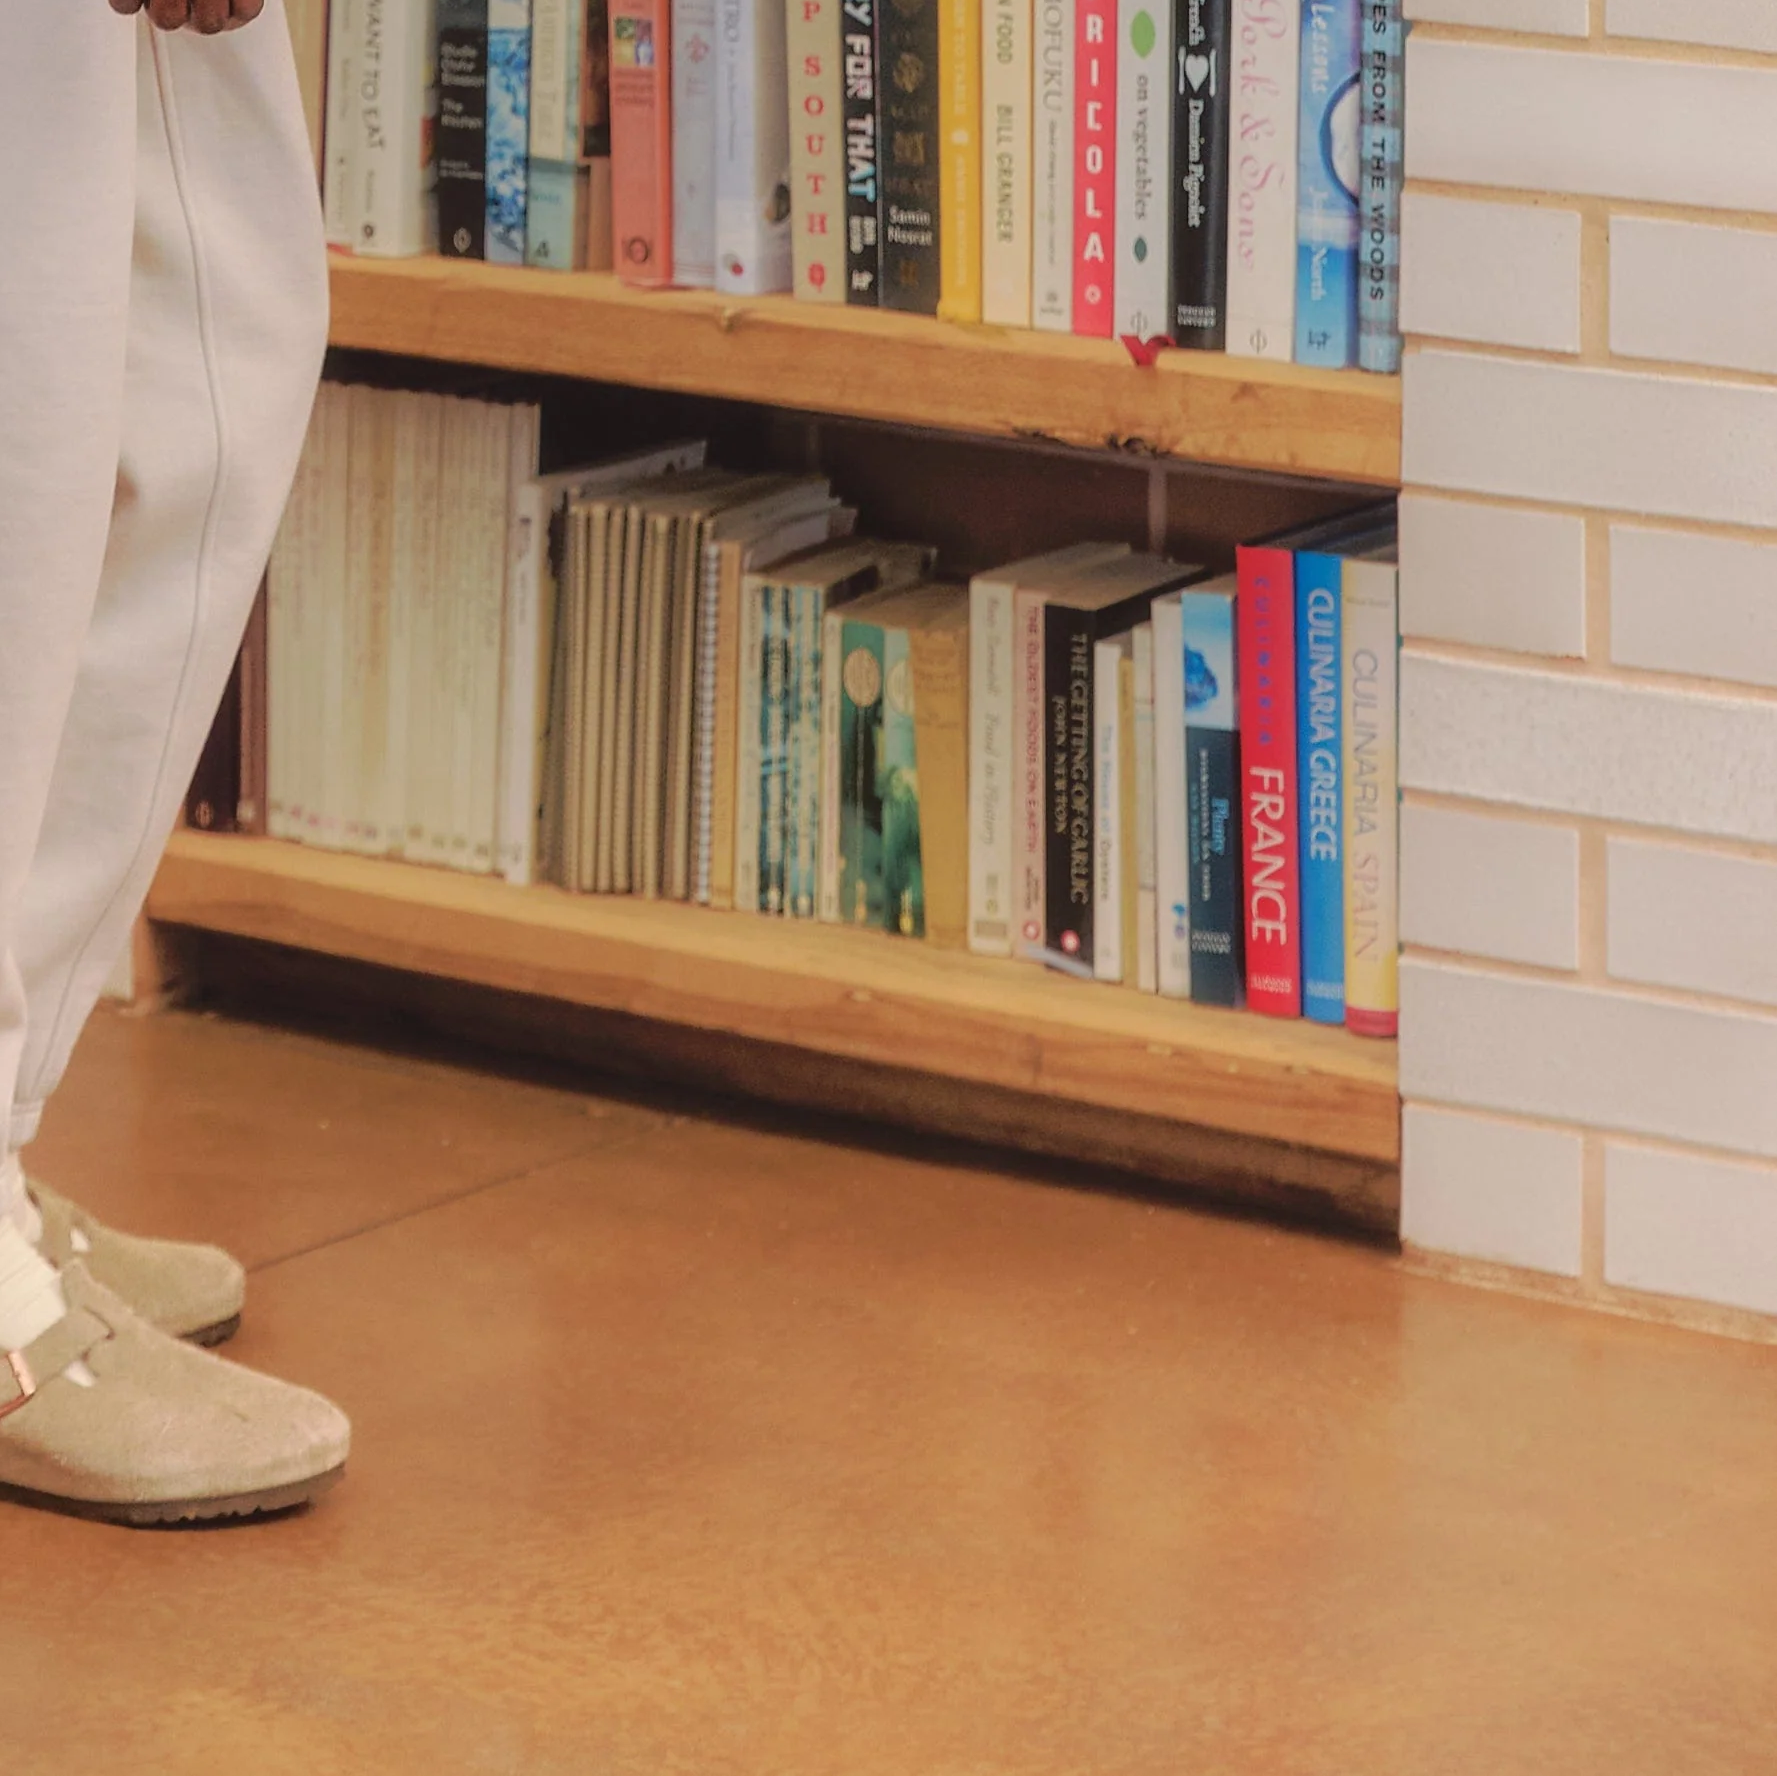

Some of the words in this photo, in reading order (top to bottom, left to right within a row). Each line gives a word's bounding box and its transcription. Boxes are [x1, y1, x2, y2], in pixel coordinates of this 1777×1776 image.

[843, 33, 874, 100] FOR
[997, 13, 1014, 66] FOOD
[1311, 3, 1334, 94] Lessons
[361, 63, 382, 102] TO
[1136, 74, 1149, 102] on
[1371, 49, 1387, 125] FROM
[361, 108, 385, 153] EAT
[803, 56, 829, 236] SOUTH
[846, 113, 876, 202] THAT
[997, 103, 1014, 146] BILL
[1187, 98, 1205, 162] Damien
[1238, 111, 1276, 142] &
[997, 152, 1014, 243] GRANGER
[1132, 105, 1152, 221] vegetables
[1371, 137, 1387, 189] THE
[1239, 154, 1286, 272] Sons
[1310, 246, 1328, 301] North
[1371, 204, 1387, 301] WOODS
[1025, 605, 1040, 634] THE
[1069, 632, 1089, 678] THE
[1254, 576, 1273, 746] CULINARIA
[1307, 587, 1337, 746] CULINARIA
[1052, 695, 1069, 749] JOHN
[1069, 679, 1089, 780] GETTING
[1351, 649, 1380, 838] CULINARIA
[982, 785, 1001, 846] History
[1025, 798, 1040, 854] EARTH
[1052, 752, 1069, 835] NEWTON
[1069, 782, 1089, 811] OF
[1210, 796, 1230, 856] Plenty
[1307, 747, 1337, 863] GREECE
[1069, 810, 1089, 905] GARLIC
[1250, 766, 1287, 946] FRANCE
[1351, 849, 1380, 964] SPAIN
